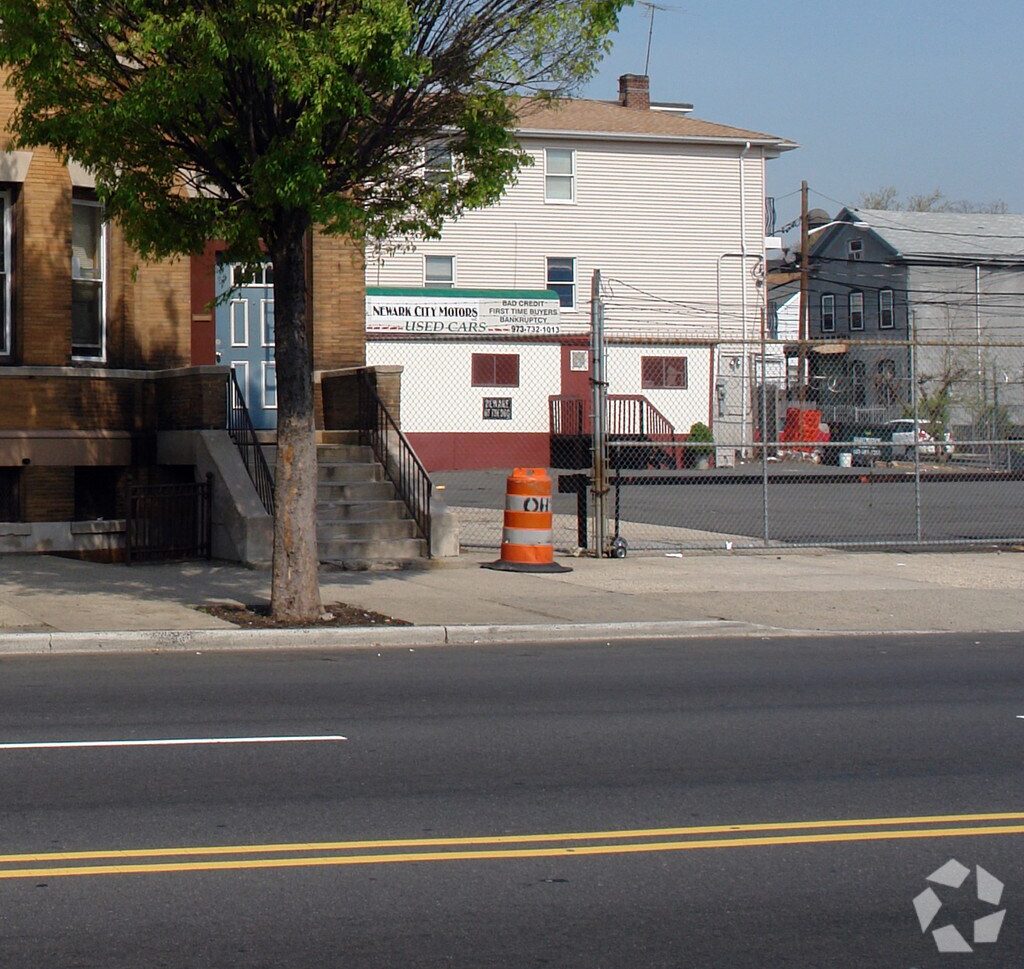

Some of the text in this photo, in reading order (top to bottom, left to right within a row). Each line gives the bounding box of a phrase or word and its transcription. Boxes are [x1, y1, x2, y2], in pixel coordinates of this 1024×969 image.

[502, 299, 517, 307] BAD
[372, 305, 478, 318] NEWARK CITY MOTORS
[489, 307, 508, 315] FIRST
[529, 308, 558, 316] BUYERS
[500, 316, 547, 324] BANKRUPTCY
[405, 321, 487, 333] USED CARS
